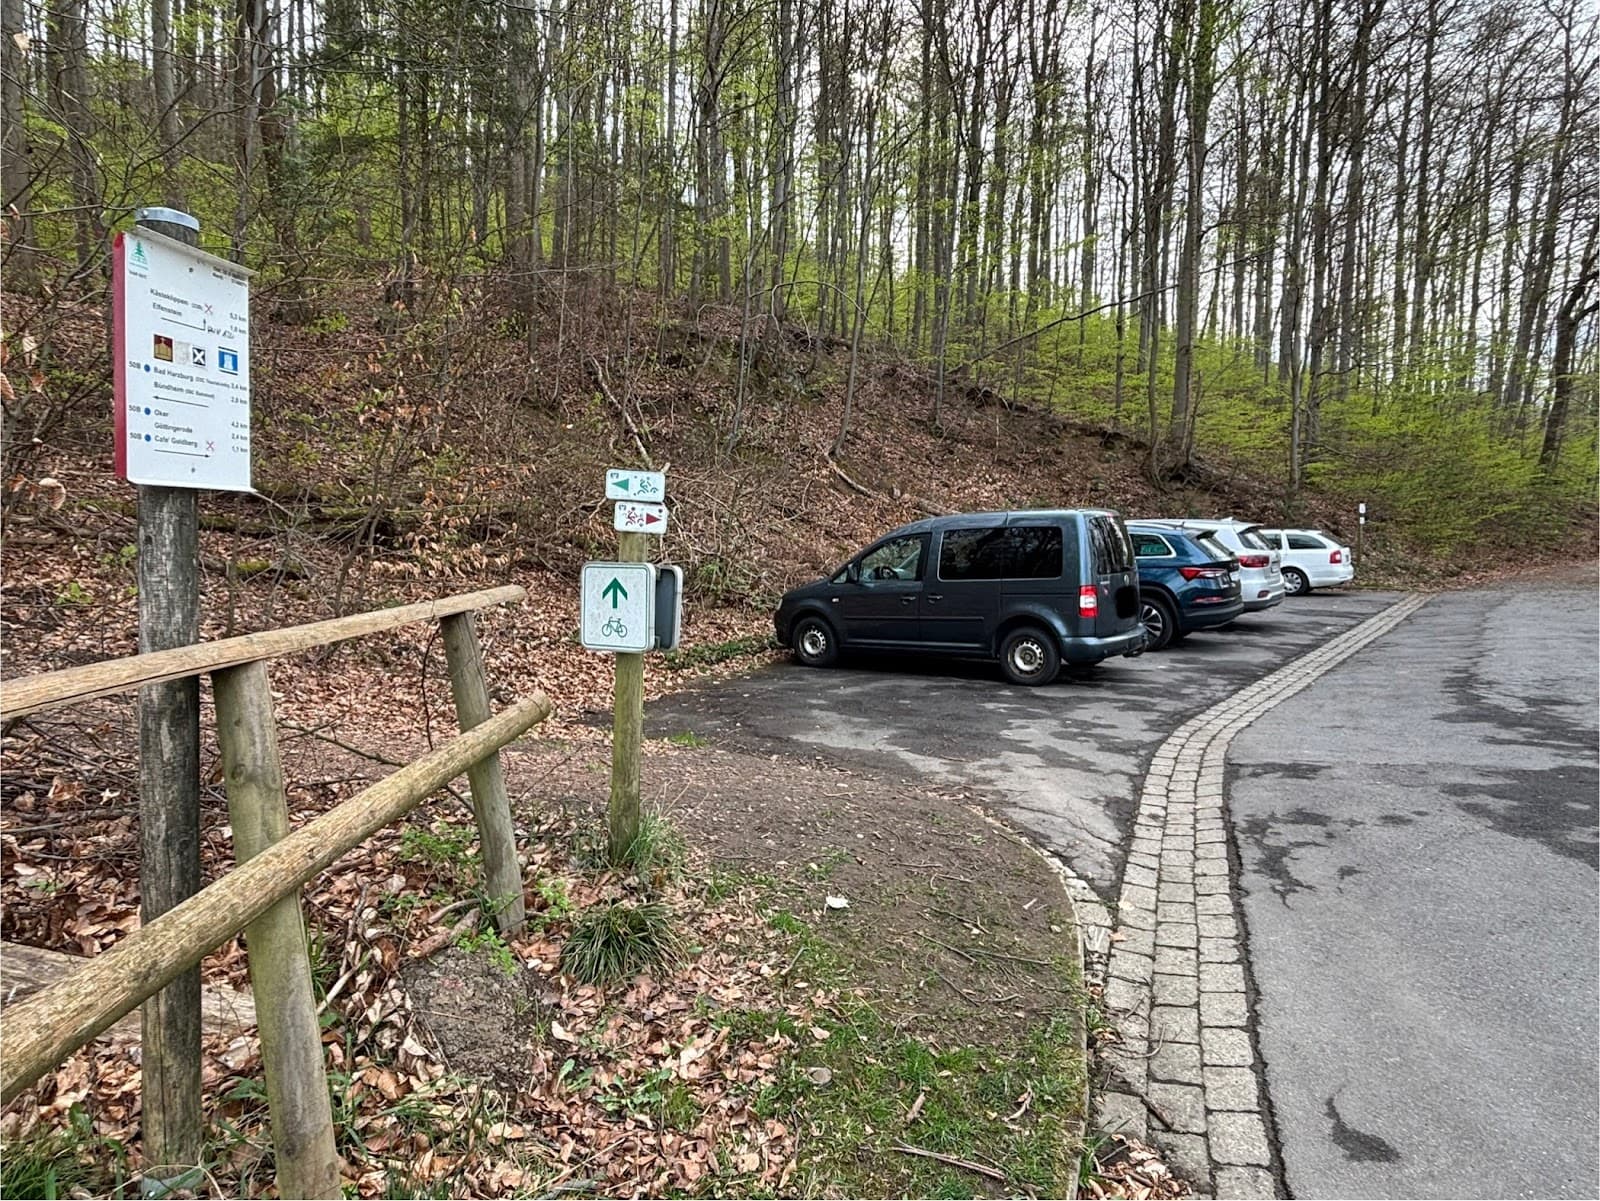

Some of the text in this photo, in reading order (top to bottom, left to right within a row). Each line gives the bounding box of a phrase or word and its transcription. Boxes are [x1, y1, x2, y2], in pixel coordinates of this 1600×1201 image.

[153, 366, 166, 375] Bad
[167, 369, 194, 383] Harzburg
[153, 381, 184, 393] Bündheim
[170, 437, 198, 449] Goldberg
